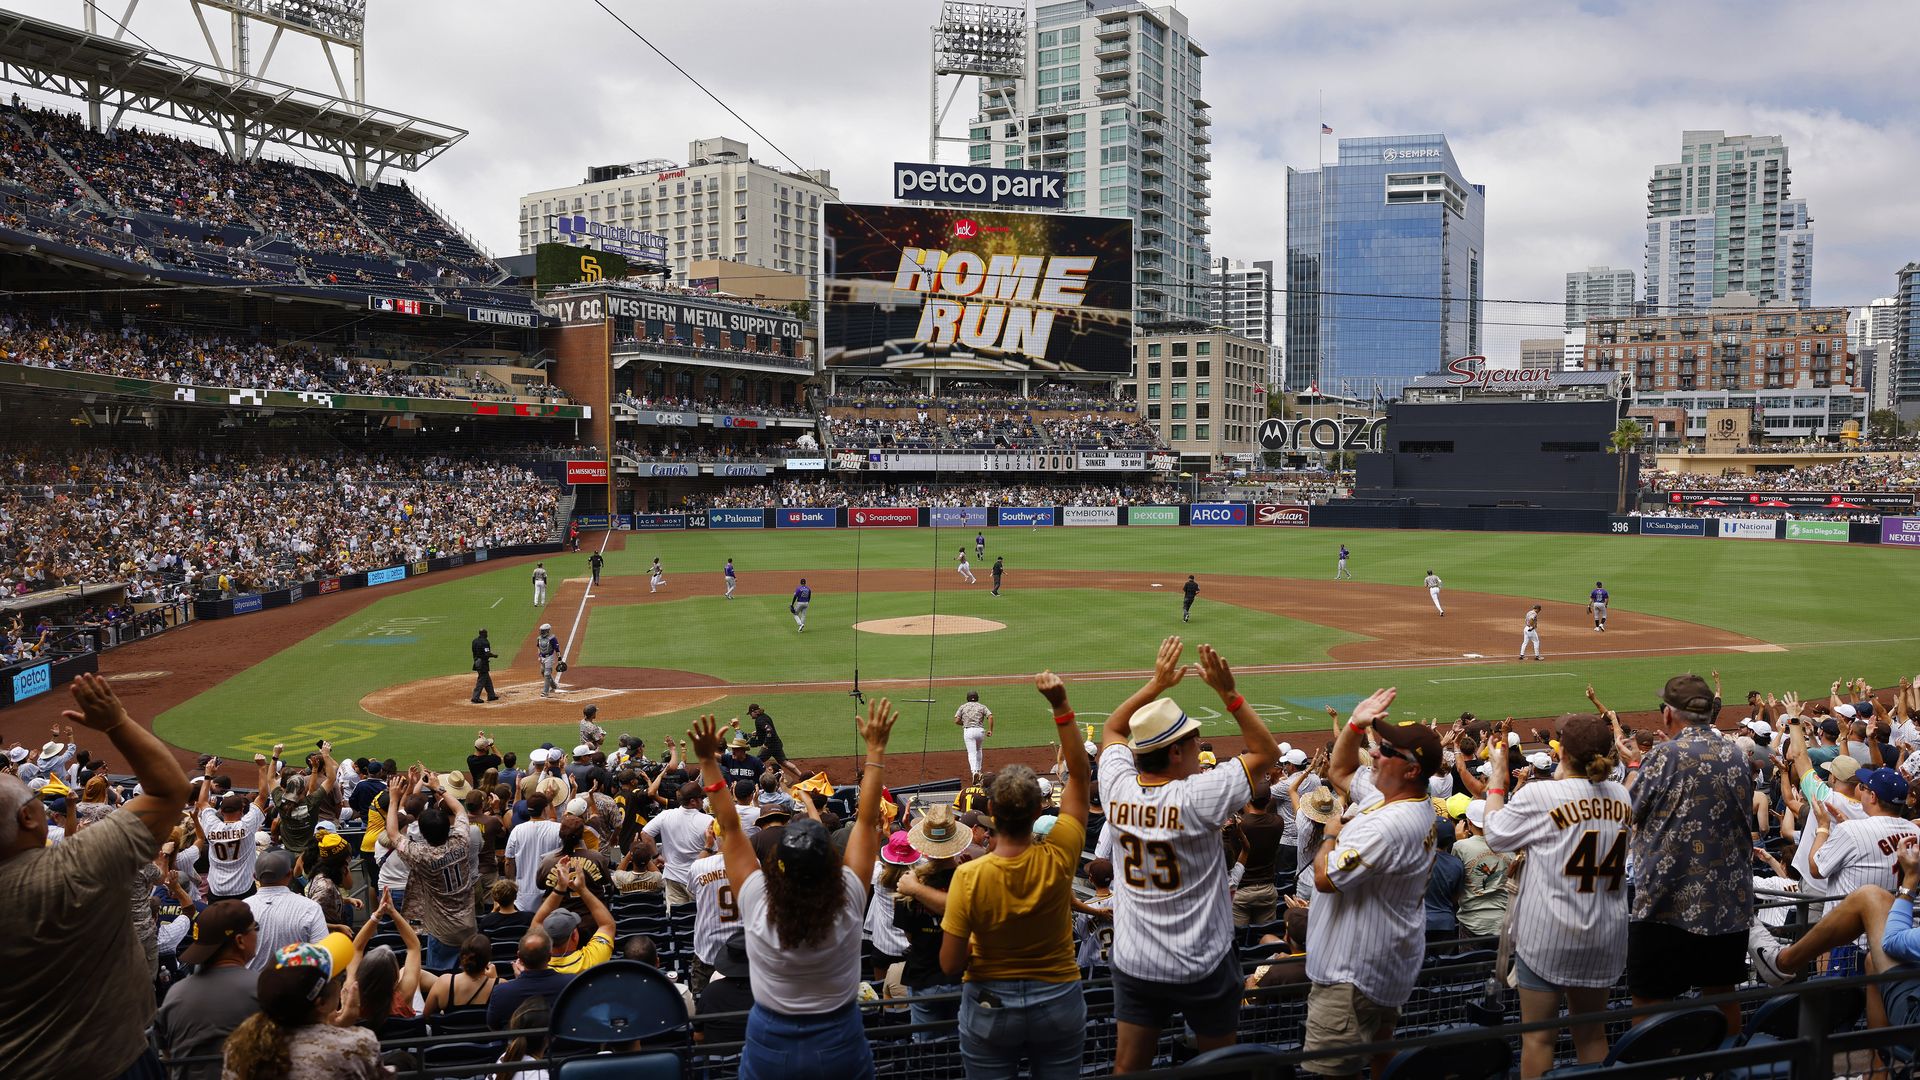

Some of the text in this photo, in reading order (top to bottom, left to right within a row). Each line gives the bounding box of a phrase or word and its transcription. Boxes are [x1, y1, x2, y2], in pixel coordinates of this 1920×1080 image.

[1399, 149, 1440, 159] SEMPRA
[657, 169, 686, 182] Marriott
[898, 167, 1060, 202] petco park
[589, 221, 666, 249] QuidelOrtho
[955, 221, 976, 237] Jack
[893, 246, 1098, 307] HOME
[580, 299, 605, 320] CO.
[477, 308, 531, 327] CUTWATER
[607, 297, 802, 339] WESTERN METAL SUPPLY CO.
[914, 298, 1057, 359] RUN
[1446, 355, 1552, 392] Sycuan
[655, 413, 683, 425] ORIS
[1721, 418, 1734, 430] 19
[1291, 417, 1388, 450] razr
[836, 453, 867, 462] HOME
[1038, 457, 1073, 470] 2 0 0
[1085, 459, 1142, 467] SINKER 93 MPH
[651, 464, 689, 476] Canel's
[724, 464, 758, 476] Canel's
[840, 461, 861, 469] RUN
[724, 514, 762, 523] Palomar
[801, 513, 824, 521] bank
[869, 514, 912, 522] Snapdragon
[1002, 512, 1045, 521] Southwst
[1065, 509, 1115, 517] CYMBIOTIKA
[1192, 509, 1231, 520] ARCO
[1258, 506, 1304, 524] Sycuan
[689, 516, 706, 527] 342
[1612, 522, 1629, 533] 396
[1665, 522, 1681, 530] Diego
[1814, 528, 1832, 536] Diego
[1889, 533, 1916, 542] NEXEN
[371, 571, 385, 582] petco
[391, 567, 403, 577] petco
[234, 599, 259, 610] citycruises
[20, 668, 47, 693] petco
[1109, 801, 1185, 831] TATIS JR.
[214, 840, 241, 861] 07
[1119, 832, 1181, 891] 23
[1563, 829, 1627, 893] 44
[442, 864, 464, 893] 11
[621, 881, 658, 892] MACHADO
[718, 885, 739, 923] 9
